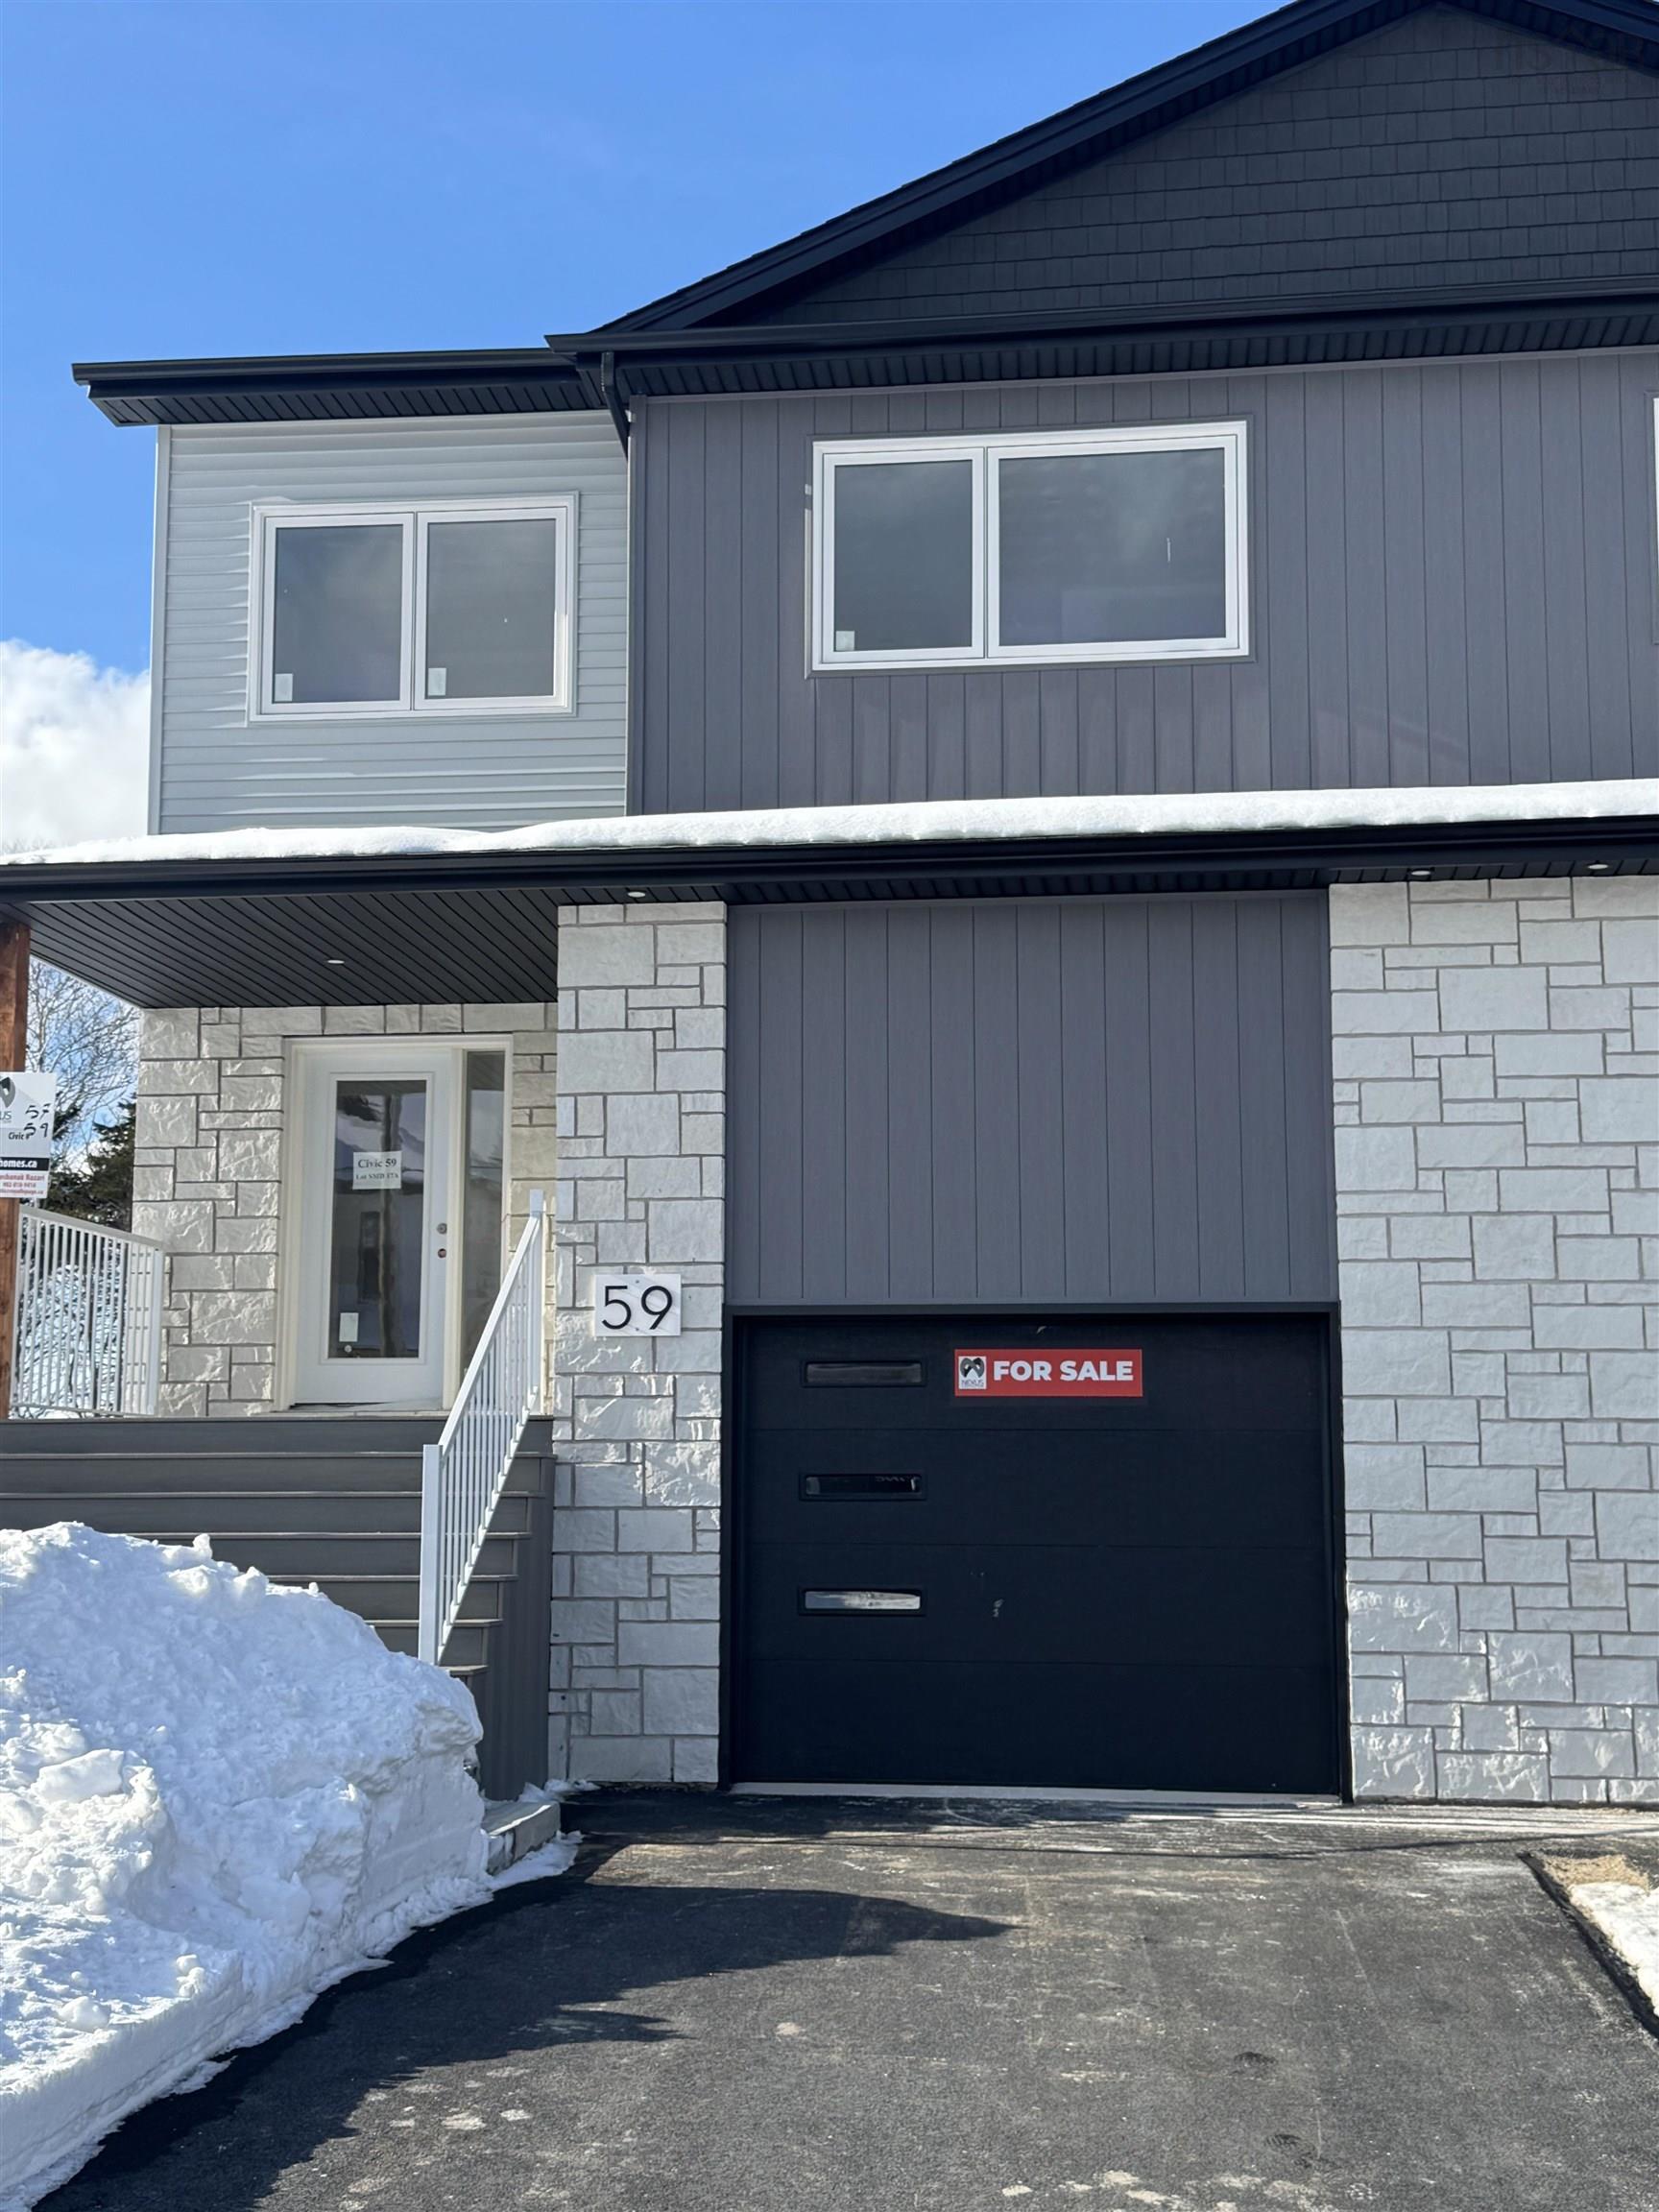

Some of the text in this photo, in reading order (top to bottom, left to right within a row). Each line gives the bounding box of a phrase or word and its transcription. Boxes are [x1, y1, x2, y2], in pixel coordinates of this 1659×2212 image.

[358, 1158, 397, 1168] Civic 59
[602, 1286, 673, 1330] 59
[993, 1360, 1134, 1382] FOR SALE
